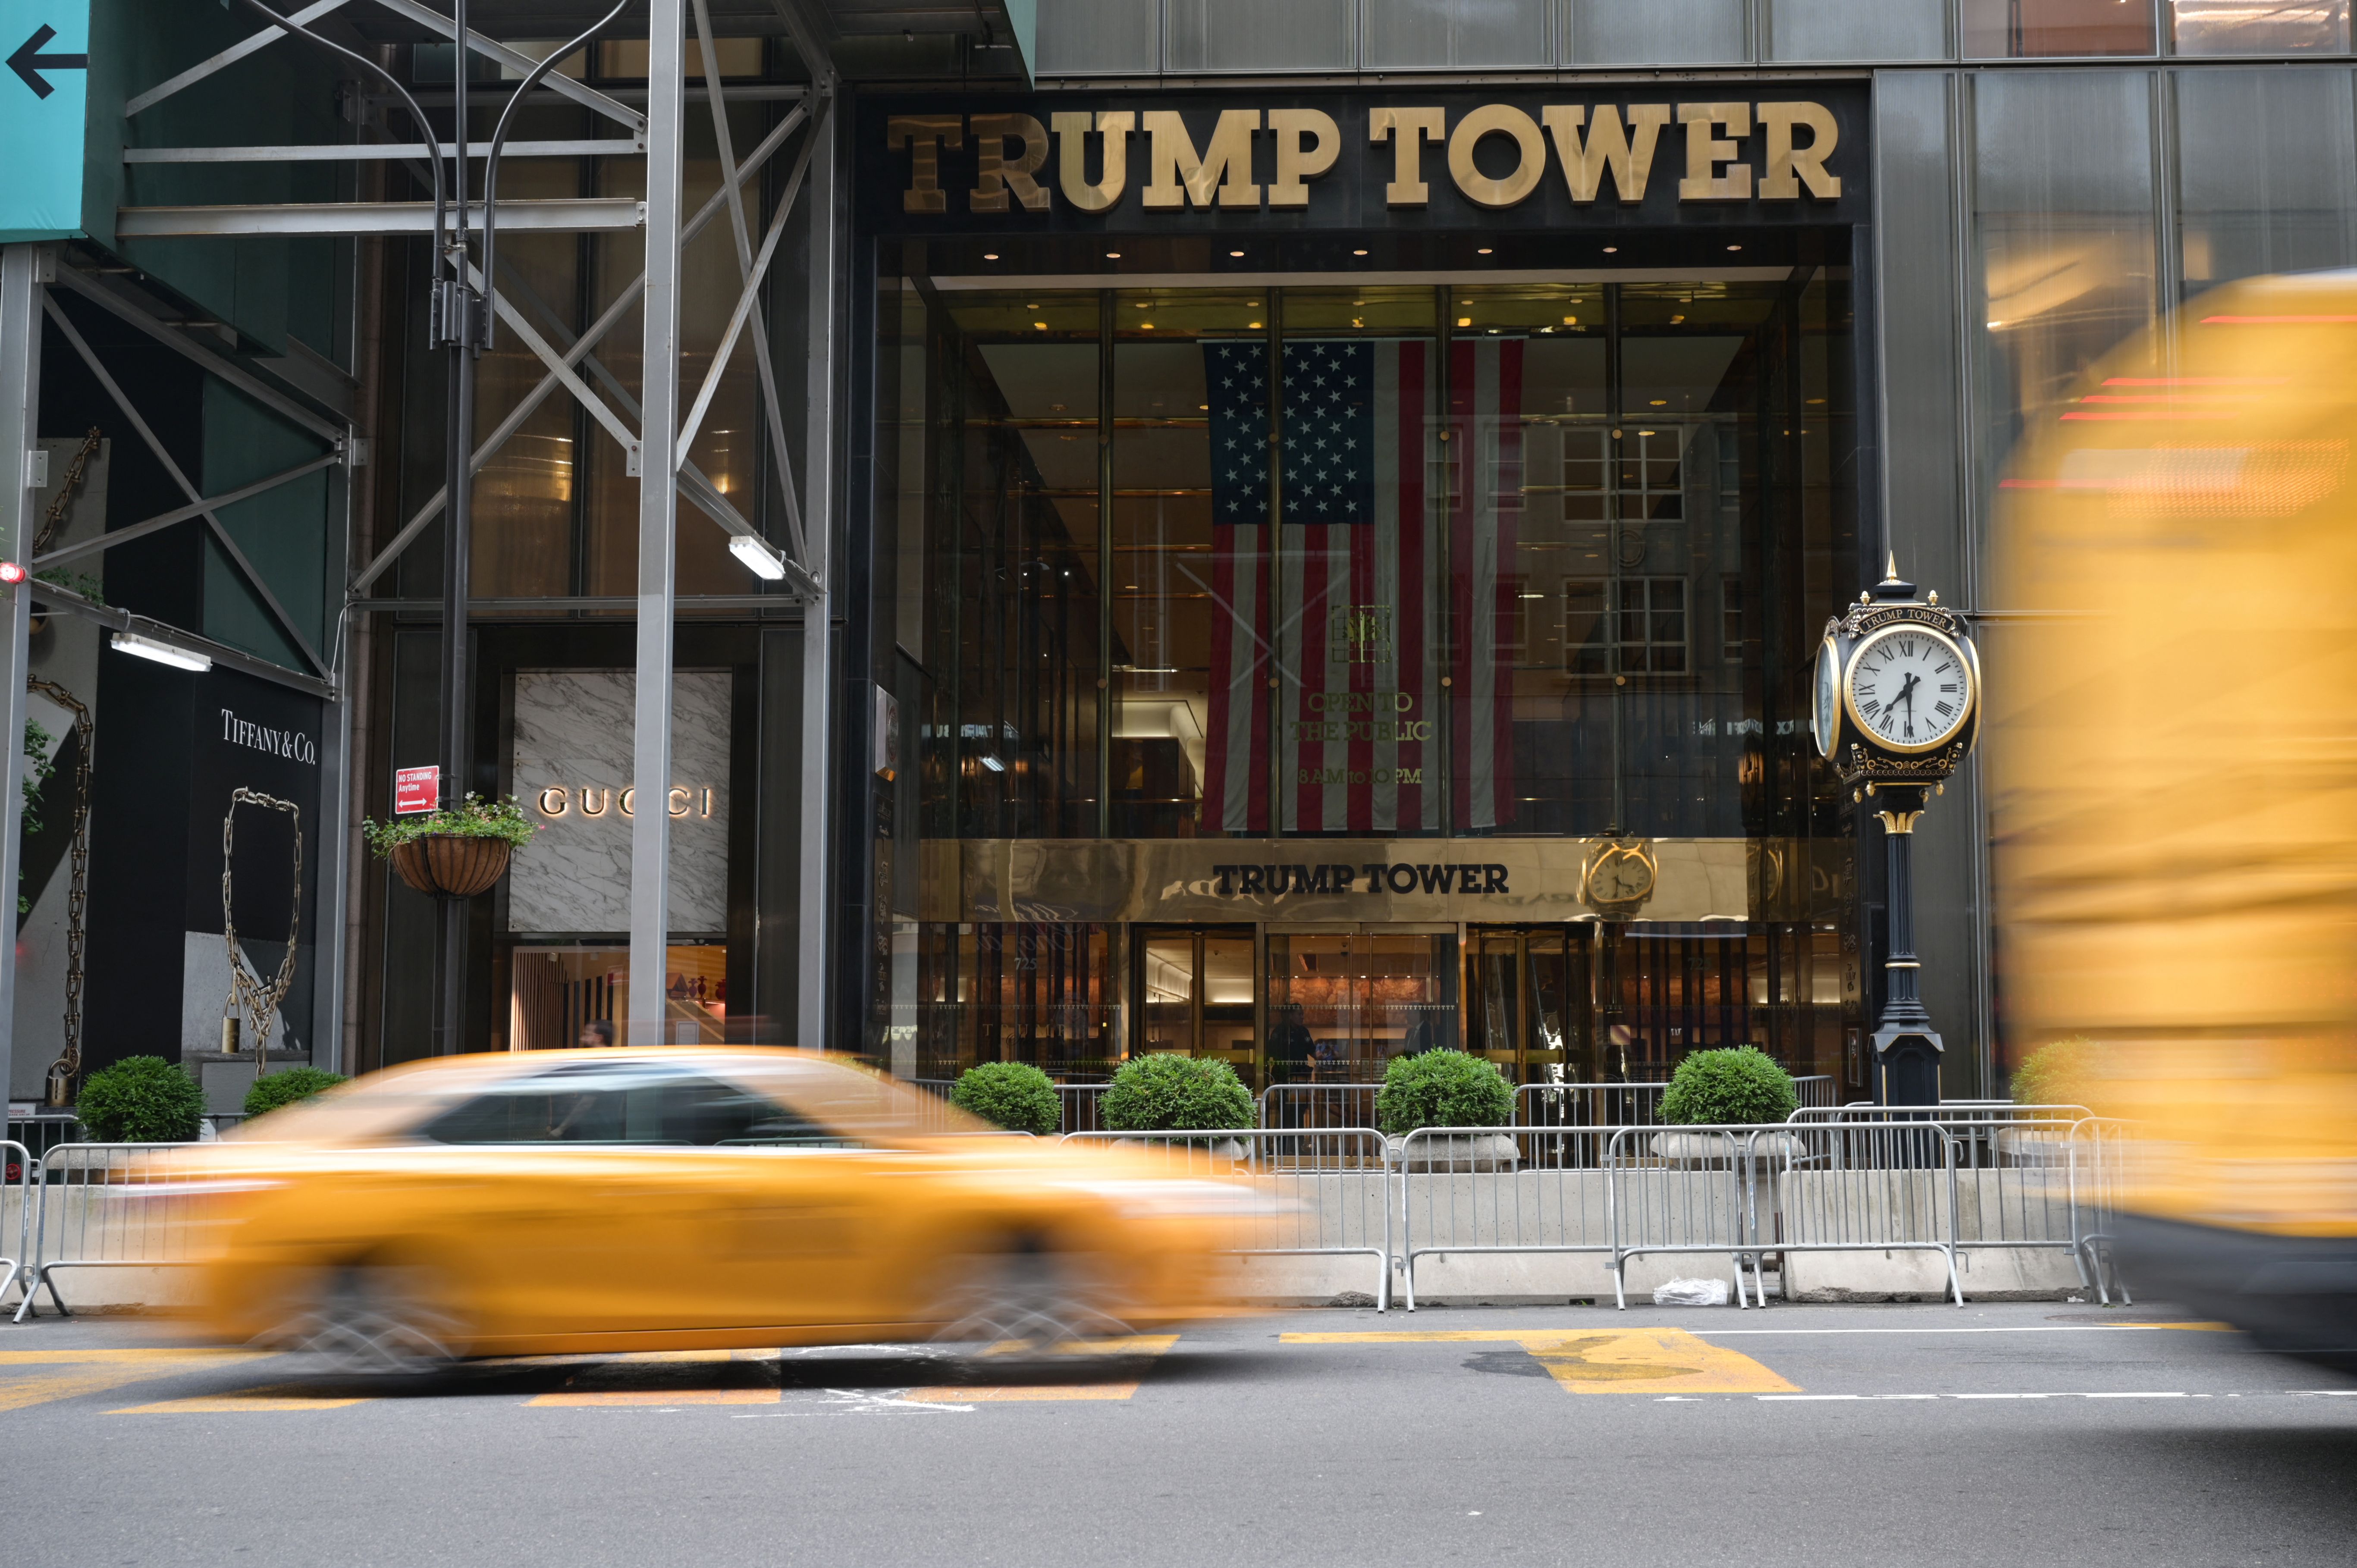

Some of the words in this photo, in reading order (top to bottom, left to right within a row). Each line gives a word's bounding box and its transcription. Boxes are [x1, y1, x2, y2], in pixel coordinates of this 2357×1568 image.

[888, 108, 1340, 214] TRUMP
[1369, 102, 1841, 209] TOWER
[1863, 609, 1902, 628] TRUMP
[1908, 609, 1946, 627] TOWER
[1308, 692, 1375, 712] OPEN
[1378, 692, 1413, 712] TO
[1290, 721, 1339, 741] THE
[1343, 721, 1431, 741] PUBLIC
[399, 775, 406, 783] NO
[407, 771, 432, 781] STANDING
[1298, 768, 1309, 784] 8
[1310, 768, 1345, 784] AM
[1348, 770, 1366, 784] to
[1369, 768, 1390, 784] 10
[1393, 768, 1422, 784] PM
[399, 783, 420, 793] Anytime
[539, 788, 709, 815] GUCCI
[1213, 864, 1355, 894] TRUMP
[1362, 863, 1509, 894] TOWER
[1014, 958, 1037, 971] 725
